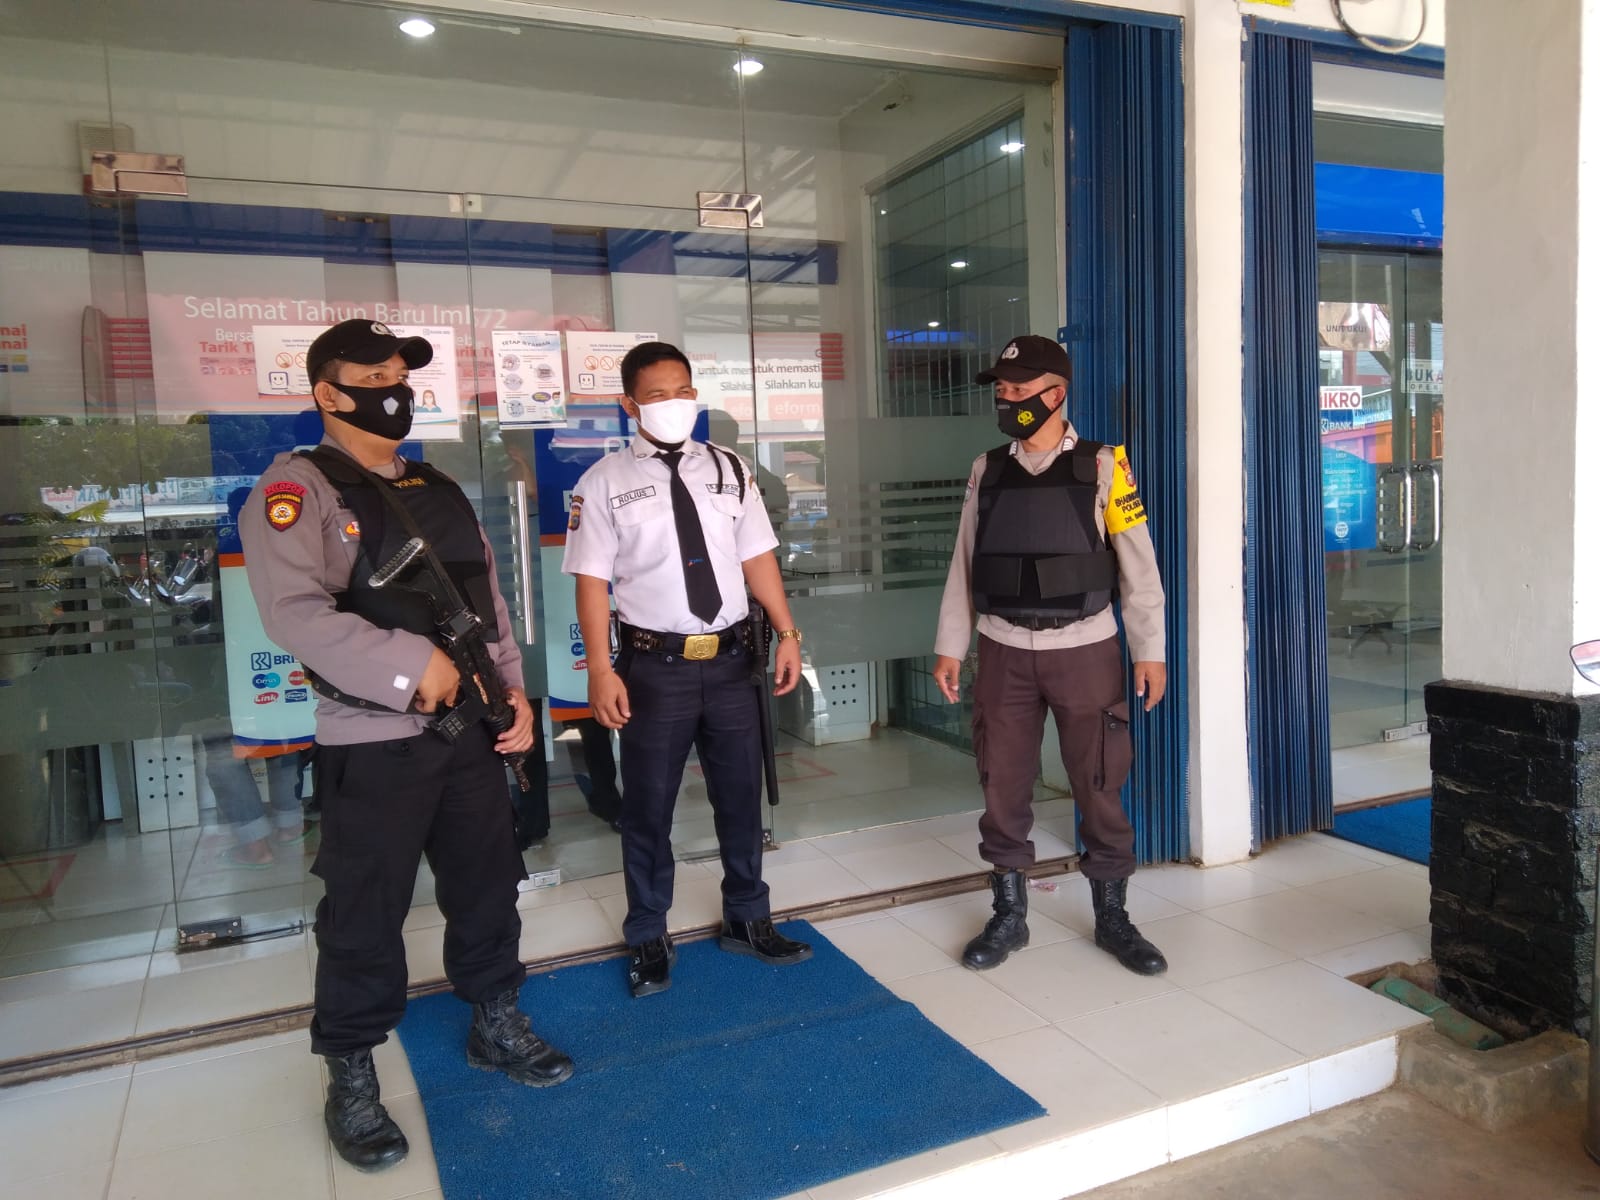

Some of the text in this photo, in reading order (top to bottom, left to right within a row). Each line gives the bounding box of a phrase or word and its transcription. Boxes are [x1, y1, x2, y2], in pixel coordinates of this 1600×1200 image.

[184, 296, 287, 320] Selamat
[291, 300, 367, 322] Tahun
[375, 303, 425, 324] Baru
[199, 341, 238, 353] Tarik
[764, 379, 807, 390] Silahkan
[1320, 392, 1361, 409] IKRO
[1329, 421, 1352, 431] BANK
[273, 654, 295, 665] BRI
[256, 693, 276, 702] Link
